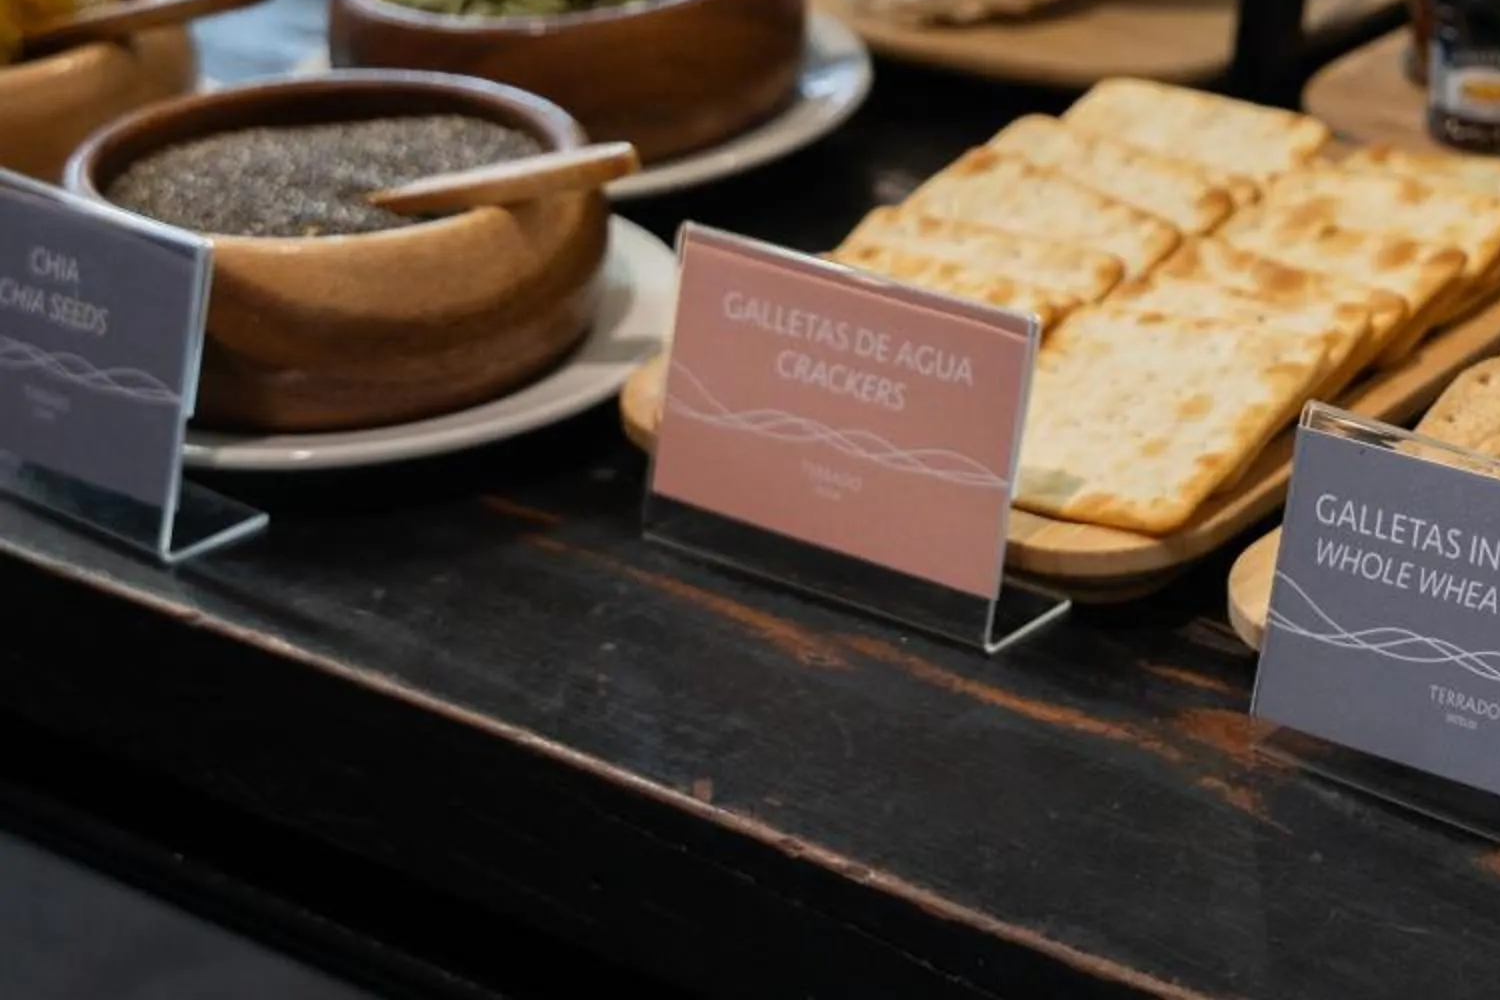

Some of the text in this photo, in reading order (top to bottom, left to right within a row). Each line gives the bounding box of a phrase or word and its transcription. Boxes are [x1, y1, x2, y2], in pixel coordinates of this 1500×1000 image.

[48, 293, 109, 335] SEEDS
[724, 291, 973, 386] GALLETAS DE AGUA
[777, 349, 907, 411] CRACKERS
[1316, 494, 1462, 559] GALLETAS
[1317, 537, 1415, 589] WHOLE
[1429, 684, 1500, 720] TERRADO
